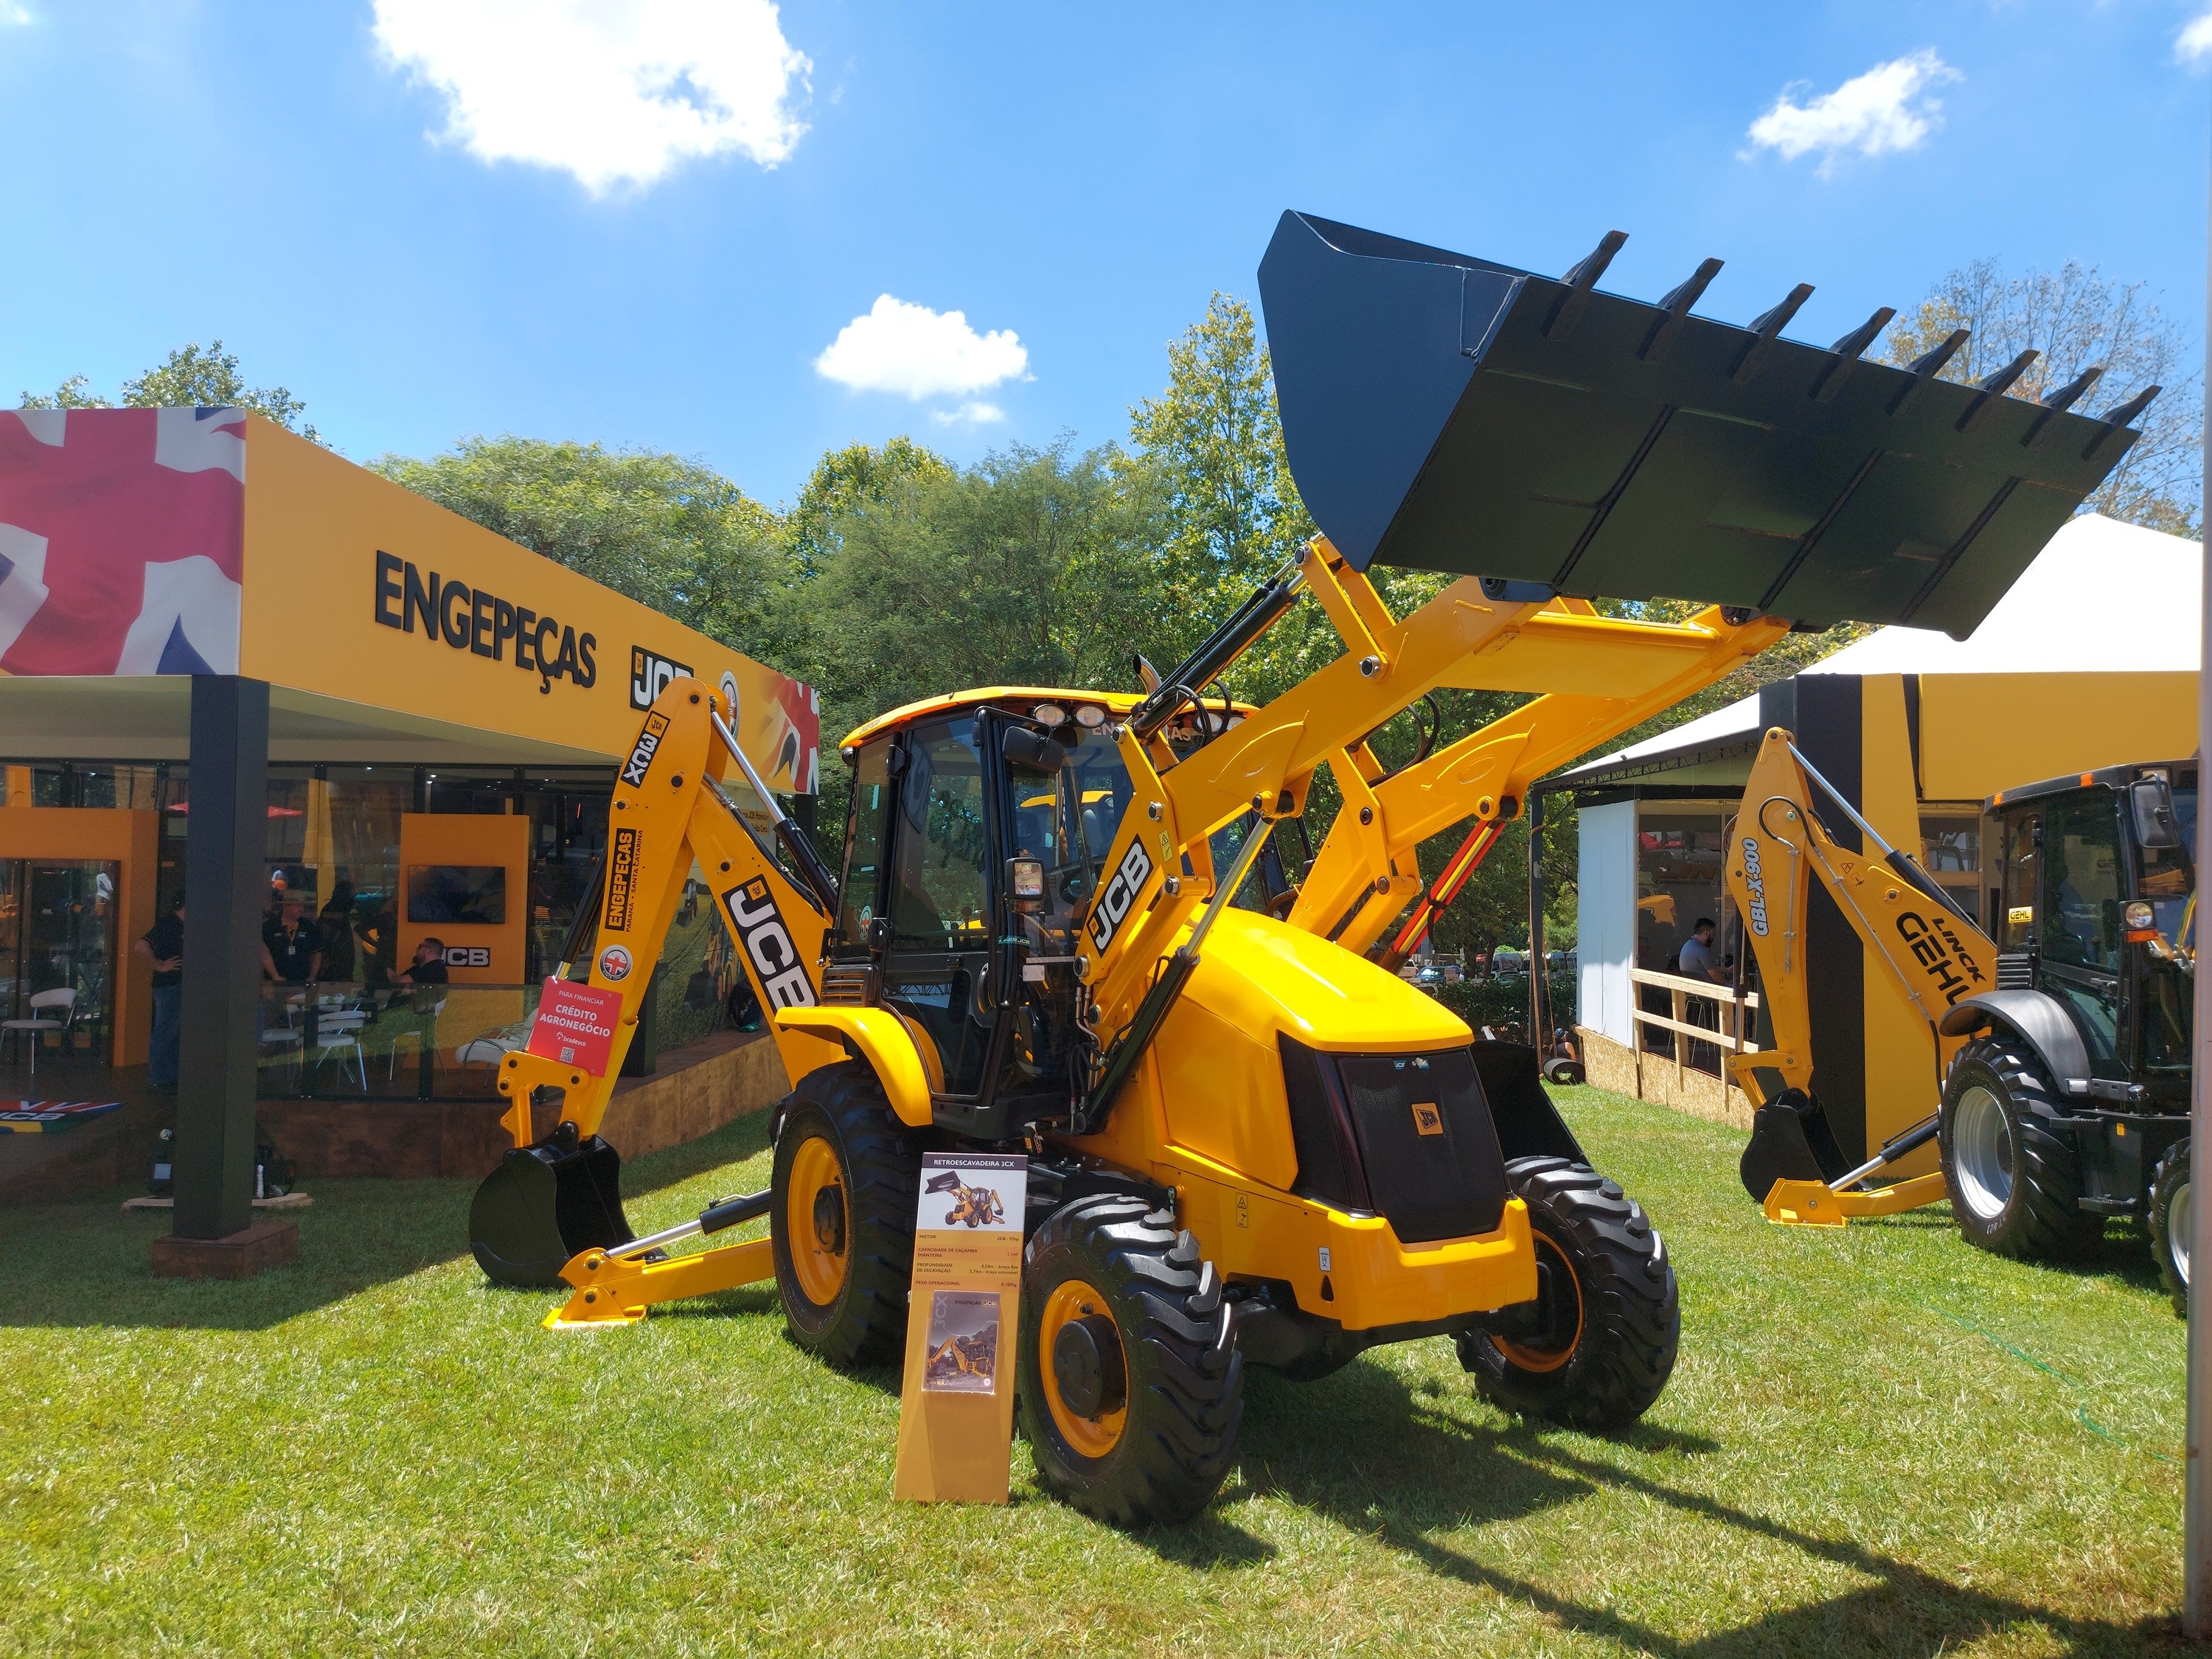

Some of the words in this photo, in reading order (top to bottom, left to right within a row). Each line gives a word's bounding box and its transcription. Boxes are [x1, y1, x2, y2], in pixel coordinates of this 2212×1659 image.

[375, 549, 597, 695] ENGEPEÇAS
[634, 655, 692, 706] JC
[651, 717, 662, 730] JCB
[623, 734, 658, 784] 3CX
[608, 832, 633, 927] ENGEPEÇAS
[630, 868, 639, 893] SANTA
[635, 830, 643, 866] CATARINA
[1742, 837, 1769, 936] GBL-X-900
[1095, 842, 1150, 950] JCB
[2010, 911, 2030, 920] GEHL
[729, 888, 816, 1012] JCB
[1896, 911, 1970, 1006] GEHL
[1932, 917, 1987, 983] LINCK
[555, 1004, 597, 1021] CRÉDITO
[559, 990, 574, 999] PARA
[574, 993, 604, 1006] FINANCIAR
[540, 1012, 611, 1037] AGRONEGÓCIO
[563, 1036, 586, 1046] bradesco
[1419, 1111, 1438, 1127] JCB
[933, 1295, 948, 1327] 3CX
